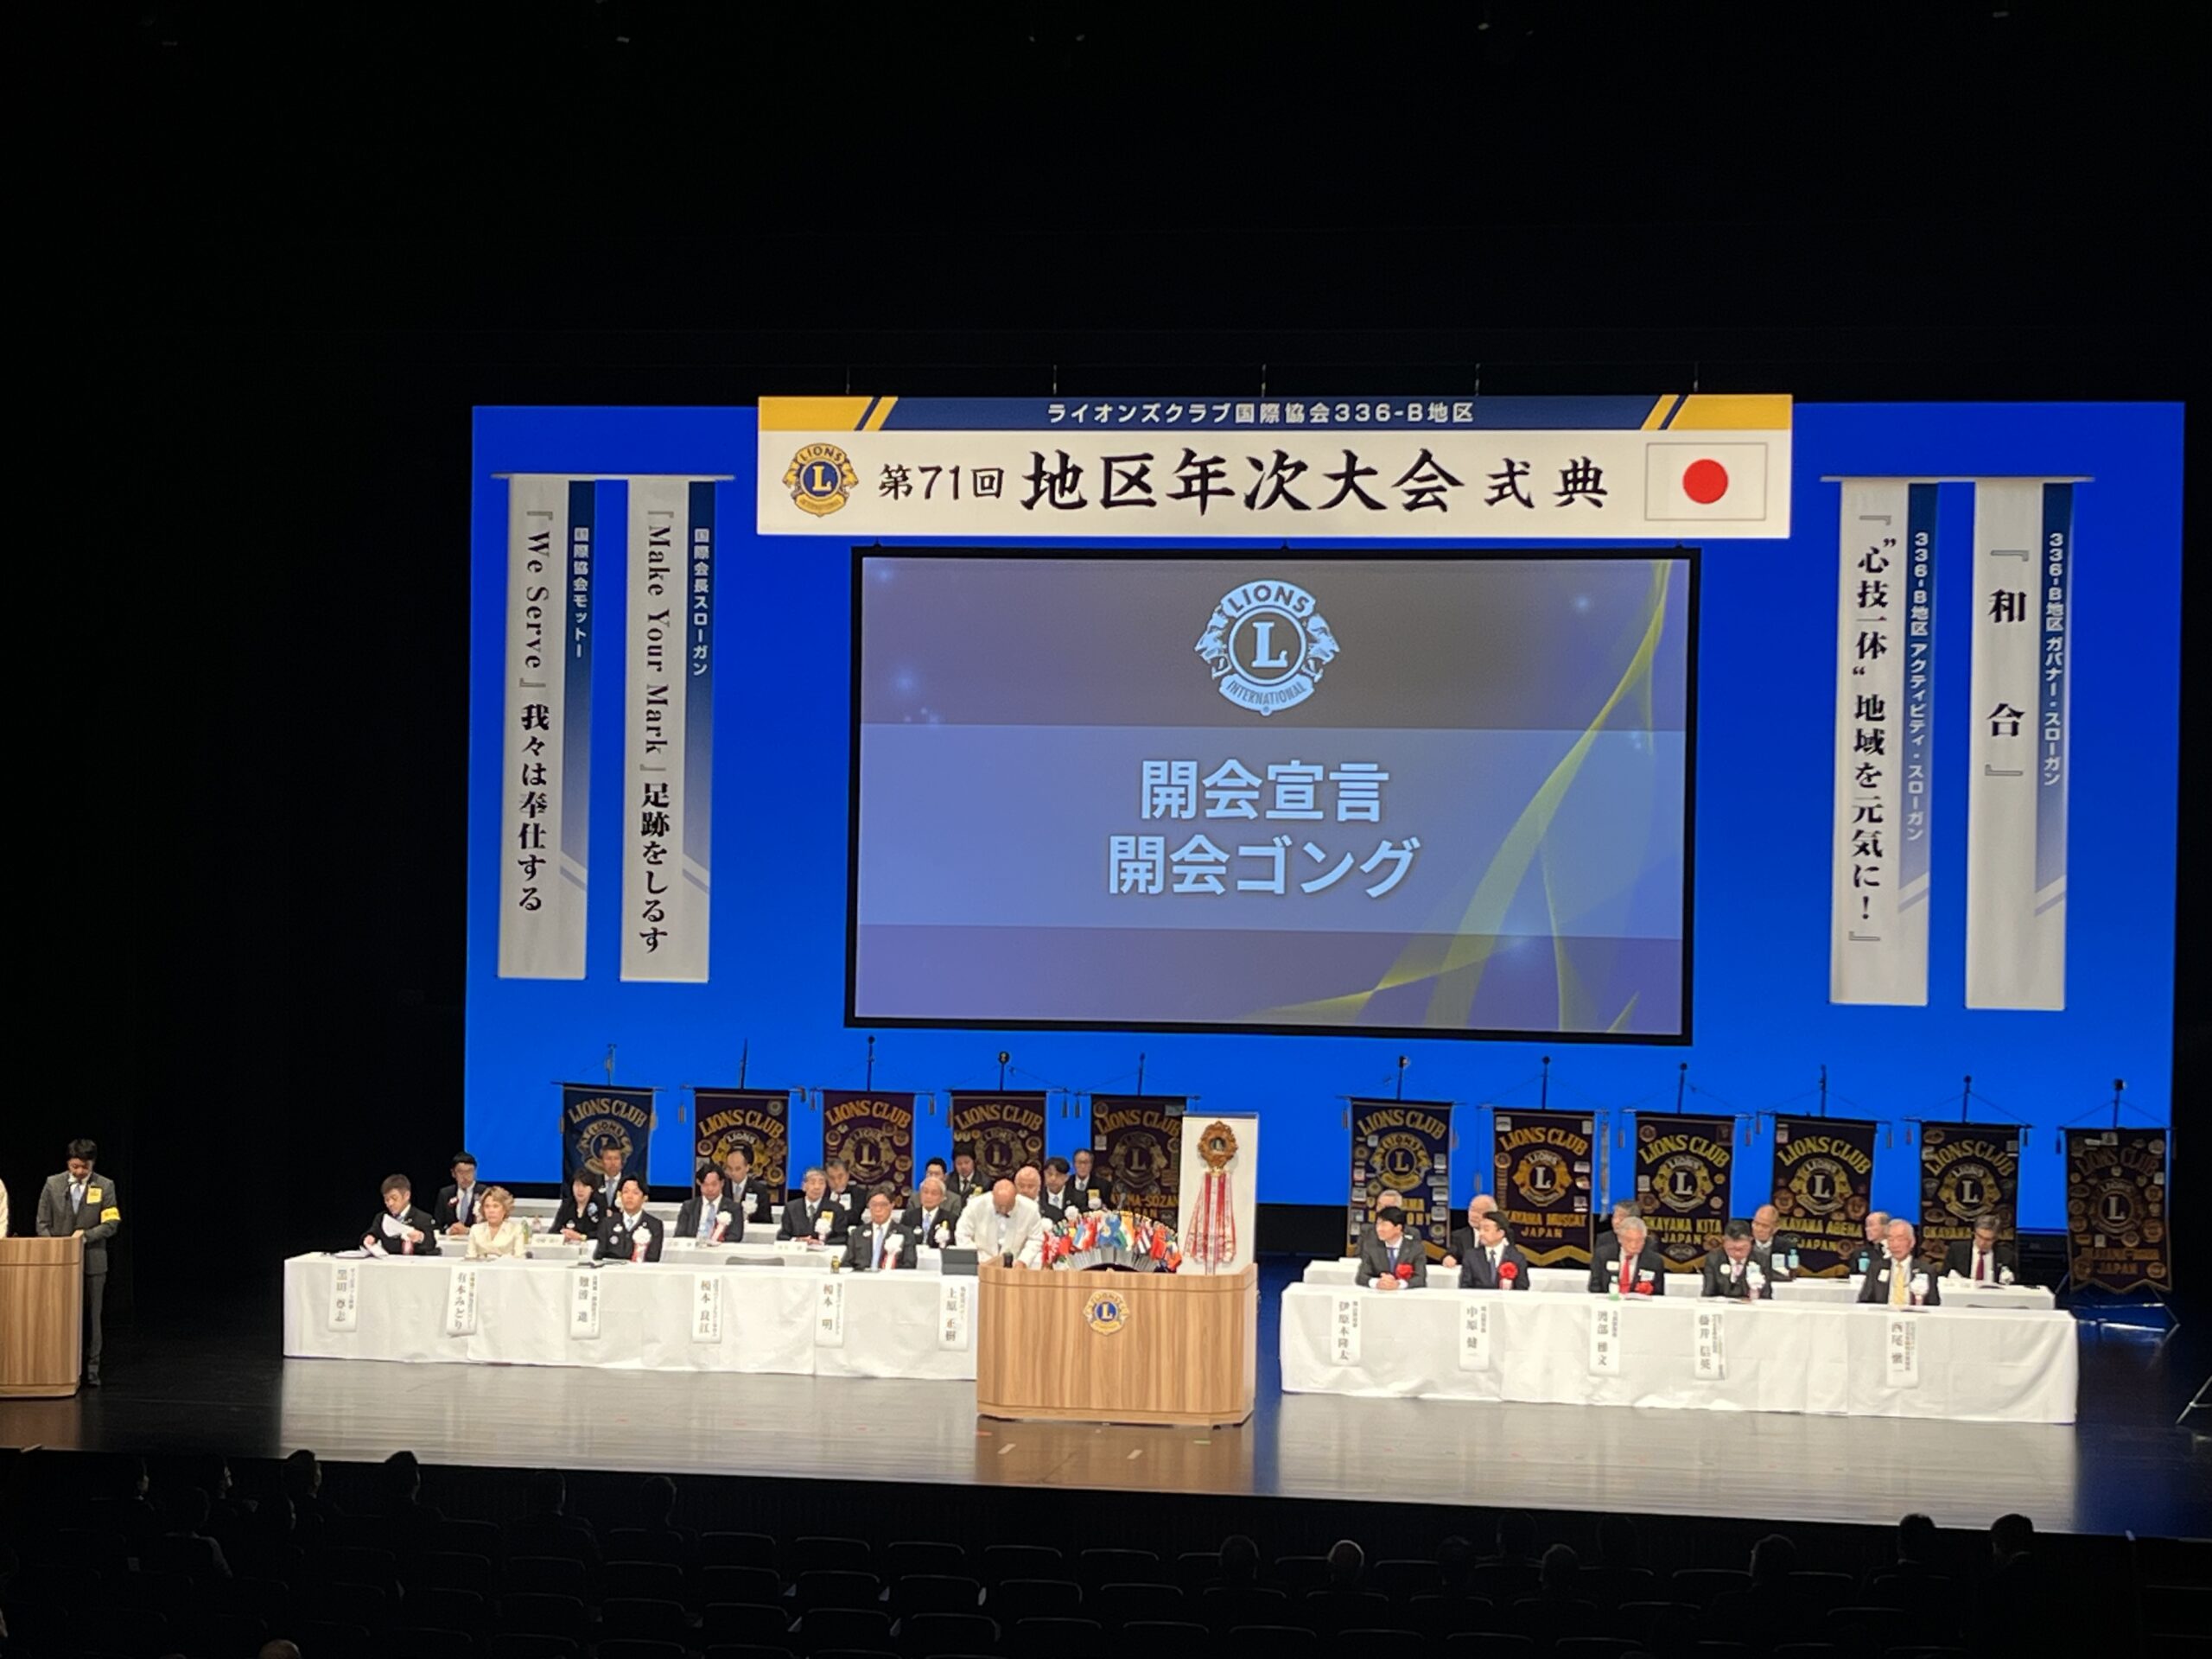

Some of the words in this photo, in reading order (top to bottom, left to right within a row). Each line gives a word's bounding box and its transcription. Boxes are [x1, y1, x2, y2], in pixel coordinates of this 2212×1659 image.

[1047, 402, 1474, 424] ライオンズクラブ国際協会336-B地区
[799, 446, 842, 461] LIONS
[812, 466, 831, 491] L
[878, 462, 1003, 501] 第71回
[1020, 448, 1465, 516] 地区年次大会
[1484, 455, 1608, 510] 式典
[1227, 584, 1310, 613] LIONS
[646, 608, 670, 672] Your
[1252, 621, 1287, 668] L
[1226, 679, 1307, 706] INTERNATIONAL
[1141, 759, 1390, 823] 開会宣言
[1109, 834, 1421, 899] 開会ゴング
[568, 1097, 611, 1124] LIONS
[610, 1099, 648, 1128] CLUB
[698, 1109, 745, 1136] LIONS
[745, 1109, 785, 1139] CLUB
[825, 1100, 871, 1126] LIONS
[872, 1101, 912, 1129] CLUB
[955, 1104, 1001, 1130] LIONS
[1002, 1104, 1044, 1132] CLUB
[1357, 1109, 1404, 1136] LIONS
[1406, 1110, 1446, 1140] CLUB
[1498, 1127, 1546, 1151] LIONS
[1547, 1128, 1588, 1156] CLUB
[1639, 1135, 1688, 1164] LIONS
[1688, 1136, 1730, 1167] CLUB
[1777, 1136, 1831, 1166] LIONS
[1830, 1139, 1872, 1174] CLUB
[1395, 1151, 1409, 1172] L
[1924, 1139, 1974, 1176] LIONS
[1974, 1140, 2016, 1177] CLUB
[1535, 1166, 1551, 1189] L
[1675, 1172, 1693, 1195] L
[1813, 1175, 1831, 1198] L
[1961, 1180, 1979, 1203] L
[2107, 1196, 2126, 1220] L
[1521, 1227, 1562, 1238] JAPAN
[1662, 1232, 1702, 1245] JAPAN
[1797, 1239, 1838, 1252] JAPAN
[1102, 1303, 1113, 1319] L
